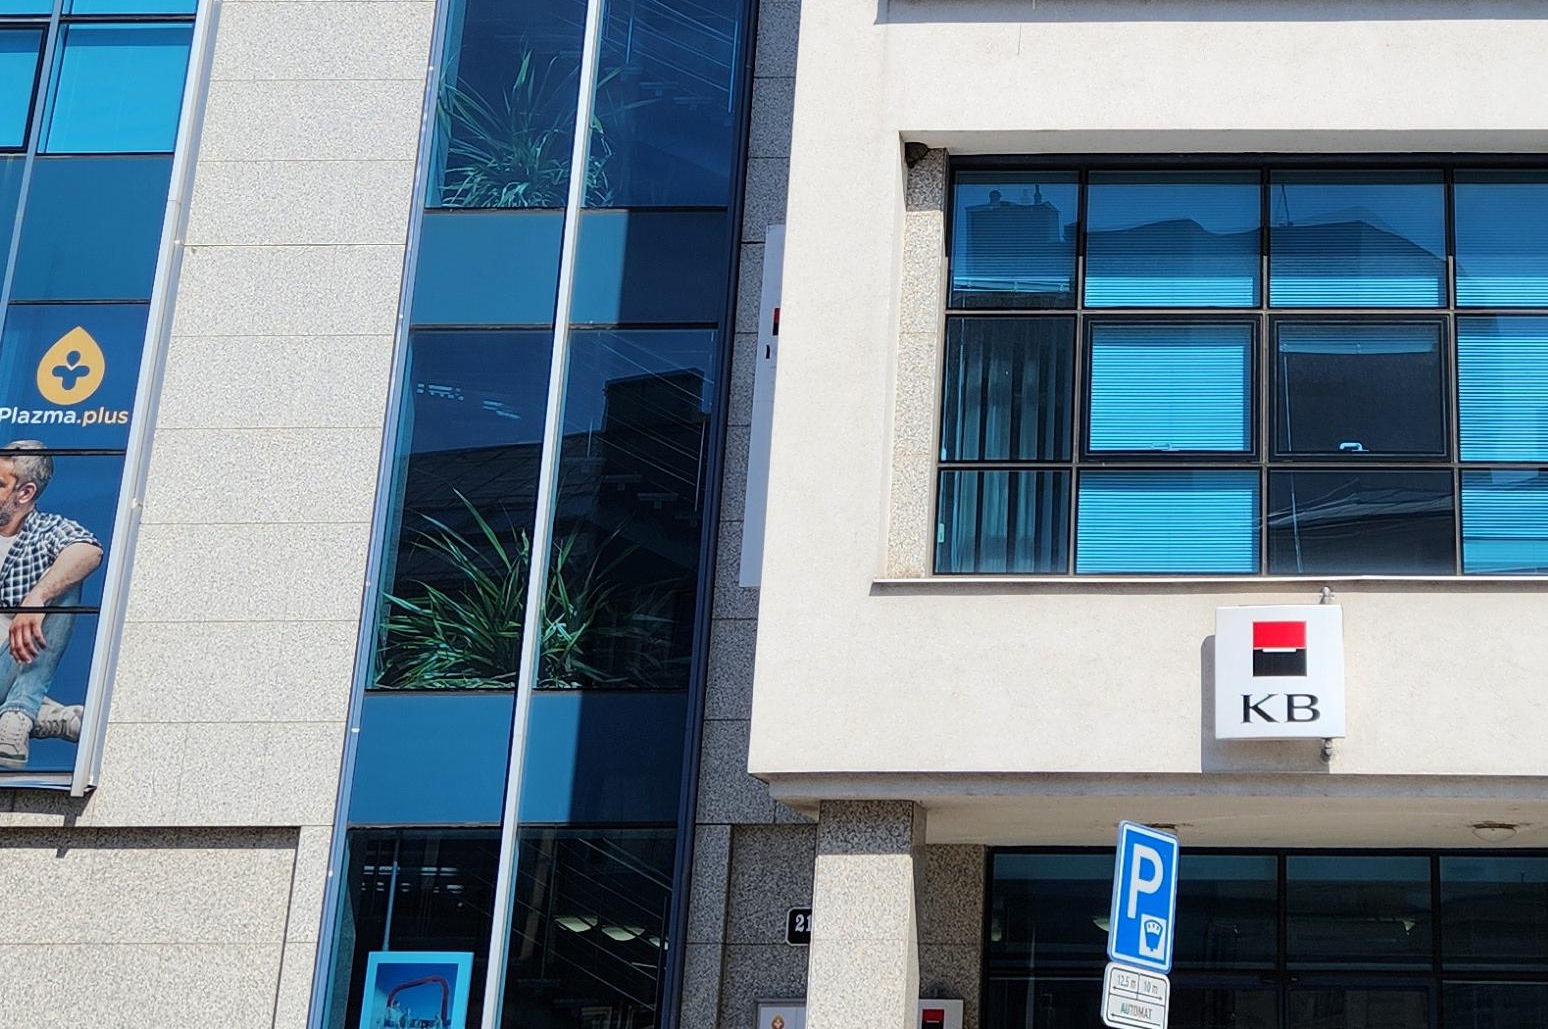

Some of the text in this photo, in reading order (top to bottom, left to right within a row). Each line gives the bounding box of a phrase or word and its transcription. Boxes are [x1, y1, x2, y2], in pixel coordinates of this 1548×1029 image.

[0, 406, 129, 427] Plazma.plus
[1240, 693, 1321, 723] KB
[1127, 843, 1164, 919] P
[1121, 1002, 1153, 1020] AUTOMAT
